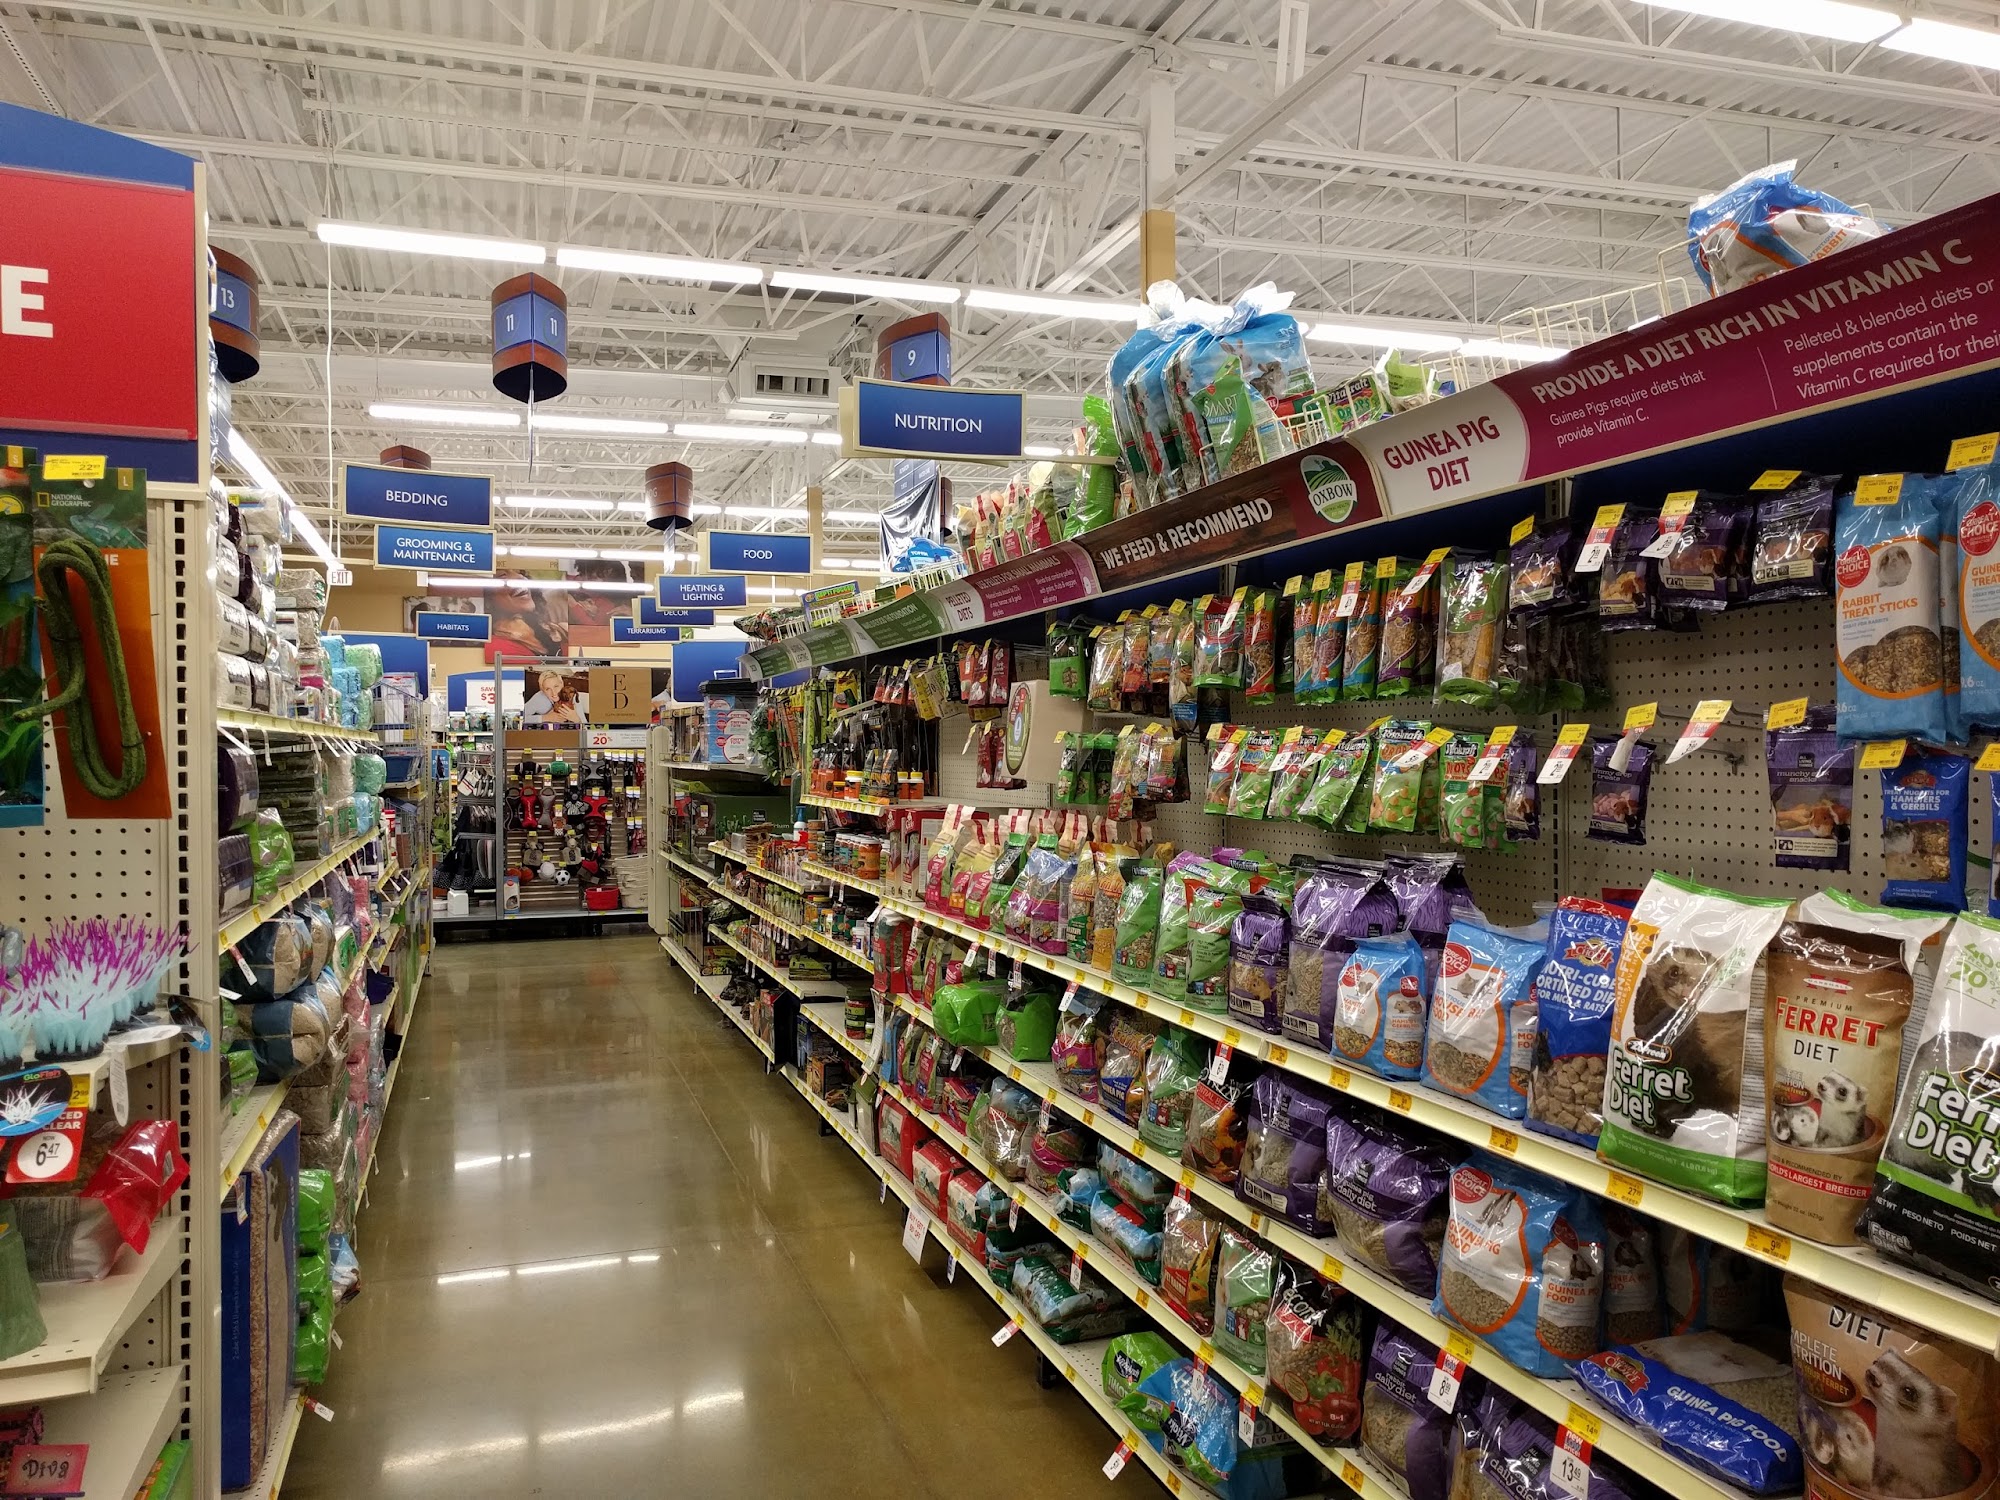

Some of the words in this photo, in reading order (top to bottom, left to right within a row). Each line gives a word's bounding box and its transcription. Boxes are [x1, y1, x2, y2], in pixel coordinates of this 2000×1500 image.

[1, 264, 53, 338] E
[220, 286, 235, 309] 13
[505, 315, 515, 333] 11
[550, 317, 559, 337] 11
[1531, 359, 1624, 404] PROVIDE
[1624, 353, 1645, 376] A
[1639, 335, 1696, 368] DIET
[1694, 309, 1764, 350] RICH
[1759, 298, 1801, 328] IN
[1795, 249, 1942, 314] VITAMIN
[1942, 238, 1973, 265] C
[1784, 323, 1843, 354] Pelleted
[1845, 319, 1860, 335] &
[1859, 296, 1928, 331] blended
[1931, 286, 1973, 310] diets
[1976, 278, 1995, 295] or
[1792, 339, 1885, 377] supplements
[1887, 321, 1946, 349] contain
[1949, 312, 1979, 331] the
[907, 349, 916, 366] 9
[1796, 371, 1850, 400] Vitamin
[1853, 367, 1867, 384] C
[1869, 344, 1935, 380] required
[1937, 341, 1962, 362] for
[1550, 408, 1586, 426] Guinea
[1585, 401, 1609, 419] Pigs
[1609, 388, 1649, 409] require
[1650, 380, 1679, 397] diets
[1680, 369, 1706, 388] that
[895, 412, 982, 434] NUTRITION
[1556, 425, 1595, 448] provide
[1593, 412, 1635, 433] Vitamin
[1635, 408, 1650, 423] C.
[1383, 422, 1460, 470] GUINEA
[1462, 416, 1501, 446] PIG
[1429, 456, 1472, 492] DIET
[51, 493, 83, 501] NATIONAL
[386, 489, 448, 507] BEDDING
[1313, 483, 1353, 507] OXBOW
[1101, 547, 1122, 570] WE
[1121, 537, 1156, 564] FEED
[1156, 532, 1170, 553] &
[1170, 497, 1274, 550] RECOMMEND
[1961, 520, 1999, 538] CHOICE
[393, 549, 476, 563] MAINTENANCE
[396, 537, 462, 551] GROOMING
[464, 541, 473, 552] &
[743, 549, 773, 560] FOOD
[331, 571, 349, 584] EXIT
[1837, 559, 1870, 576] CHOICE
[680, 584, 717, 593] HEATING
[718, 584, 725, 593] &
[682, 592, 724, 602] LIGHTING
[945, 591, 972, 608] PELLETED
[1842, 592, 1882, 610] RABBIT
[1842, 605, 1876, 620] TREAT
[1879, 597, 1918, 613] STICKS
[957, 606, 974, 622] DIETS
[436, 623, 470, 632] HABITATS
[627, 627, 667, 635] TERRARIUMS
[612, 674, 627, 691] E
[614, 692, 629, 710] D
[593, 735, 613, 746] 20%
[1777, 771, 1810, 779] munchy
[1890, 803, 1898, 811] &
[1901, 802, 1940, 812] GERBILS
[1537, 989, 1552, 1001] FOR
[1572, 999, 1582, 1009] &
[1582, 1001, 1606, 1014] RATS
[1795, 995, 1854, 1012] PREMIUM
[1776, 995, 1887, 1048] FERRET
[1793, 1038, 1840, 1064] DIET
[1613, 1047, 1692, 1102] Ferret
[1610, 1078, 1655, 1126] Diet
[41, 1121, 82, 1131] CLEAR
[1907, 1110, 1996, 1176] Diet
[1785, 1159, 1832, 1179] RECOMMENDED
[1833, 1173, 1843, 1182] BY
[1453, 1172, 1487, 1198] CHOICE
[1788, 1170, 1825, 1189] LARGEST
[1825, 1182, 1867, 1198] BREEDER
[1337, 1185, 1358, 1203] daily
[1357, 1195, 1378, 1213] diet
[1449, 1217, 1484, 1249] GUINE
[1870, 1221, 1912, 1250] Ferret
[1902, 1207, 1922, 1223] PESO
[1922, 1217, 1945, 1232] NETO
[1950, 1228, 1977, 1246] POIDS
[1977, 1238, 1998, 1253] NET
[1447, 1232, 1471, 1255] FOOD
[1546, 1292, 1575, 1305] FOOD
[1548, 1282, 1586, 1298] GUINEA
[1828, 1304, 1892, 1348] DIET
[1790, 1327, 1838, 1362] MPLETE
[1792, 1342, 1842, 1381] TRITION
[1374, 1372, 1396, 1392] daily
[1395, 1386, 1418, 1404] diet
[1822, 1374, 1850, 1397] FERRET
[1666, 1385, 1721, 1418] GUINEA
[1717, 1411, 1747, 1430] PIG
[1742, 1423, 1788, 1464] FOOD
[1565, 1429, 1584, 1445] new
[1528, 1447, 1539, 1457] ALL
[22, 1456, 70, 1480] Diva
[1489, 1458, 1518, 1486] daily
